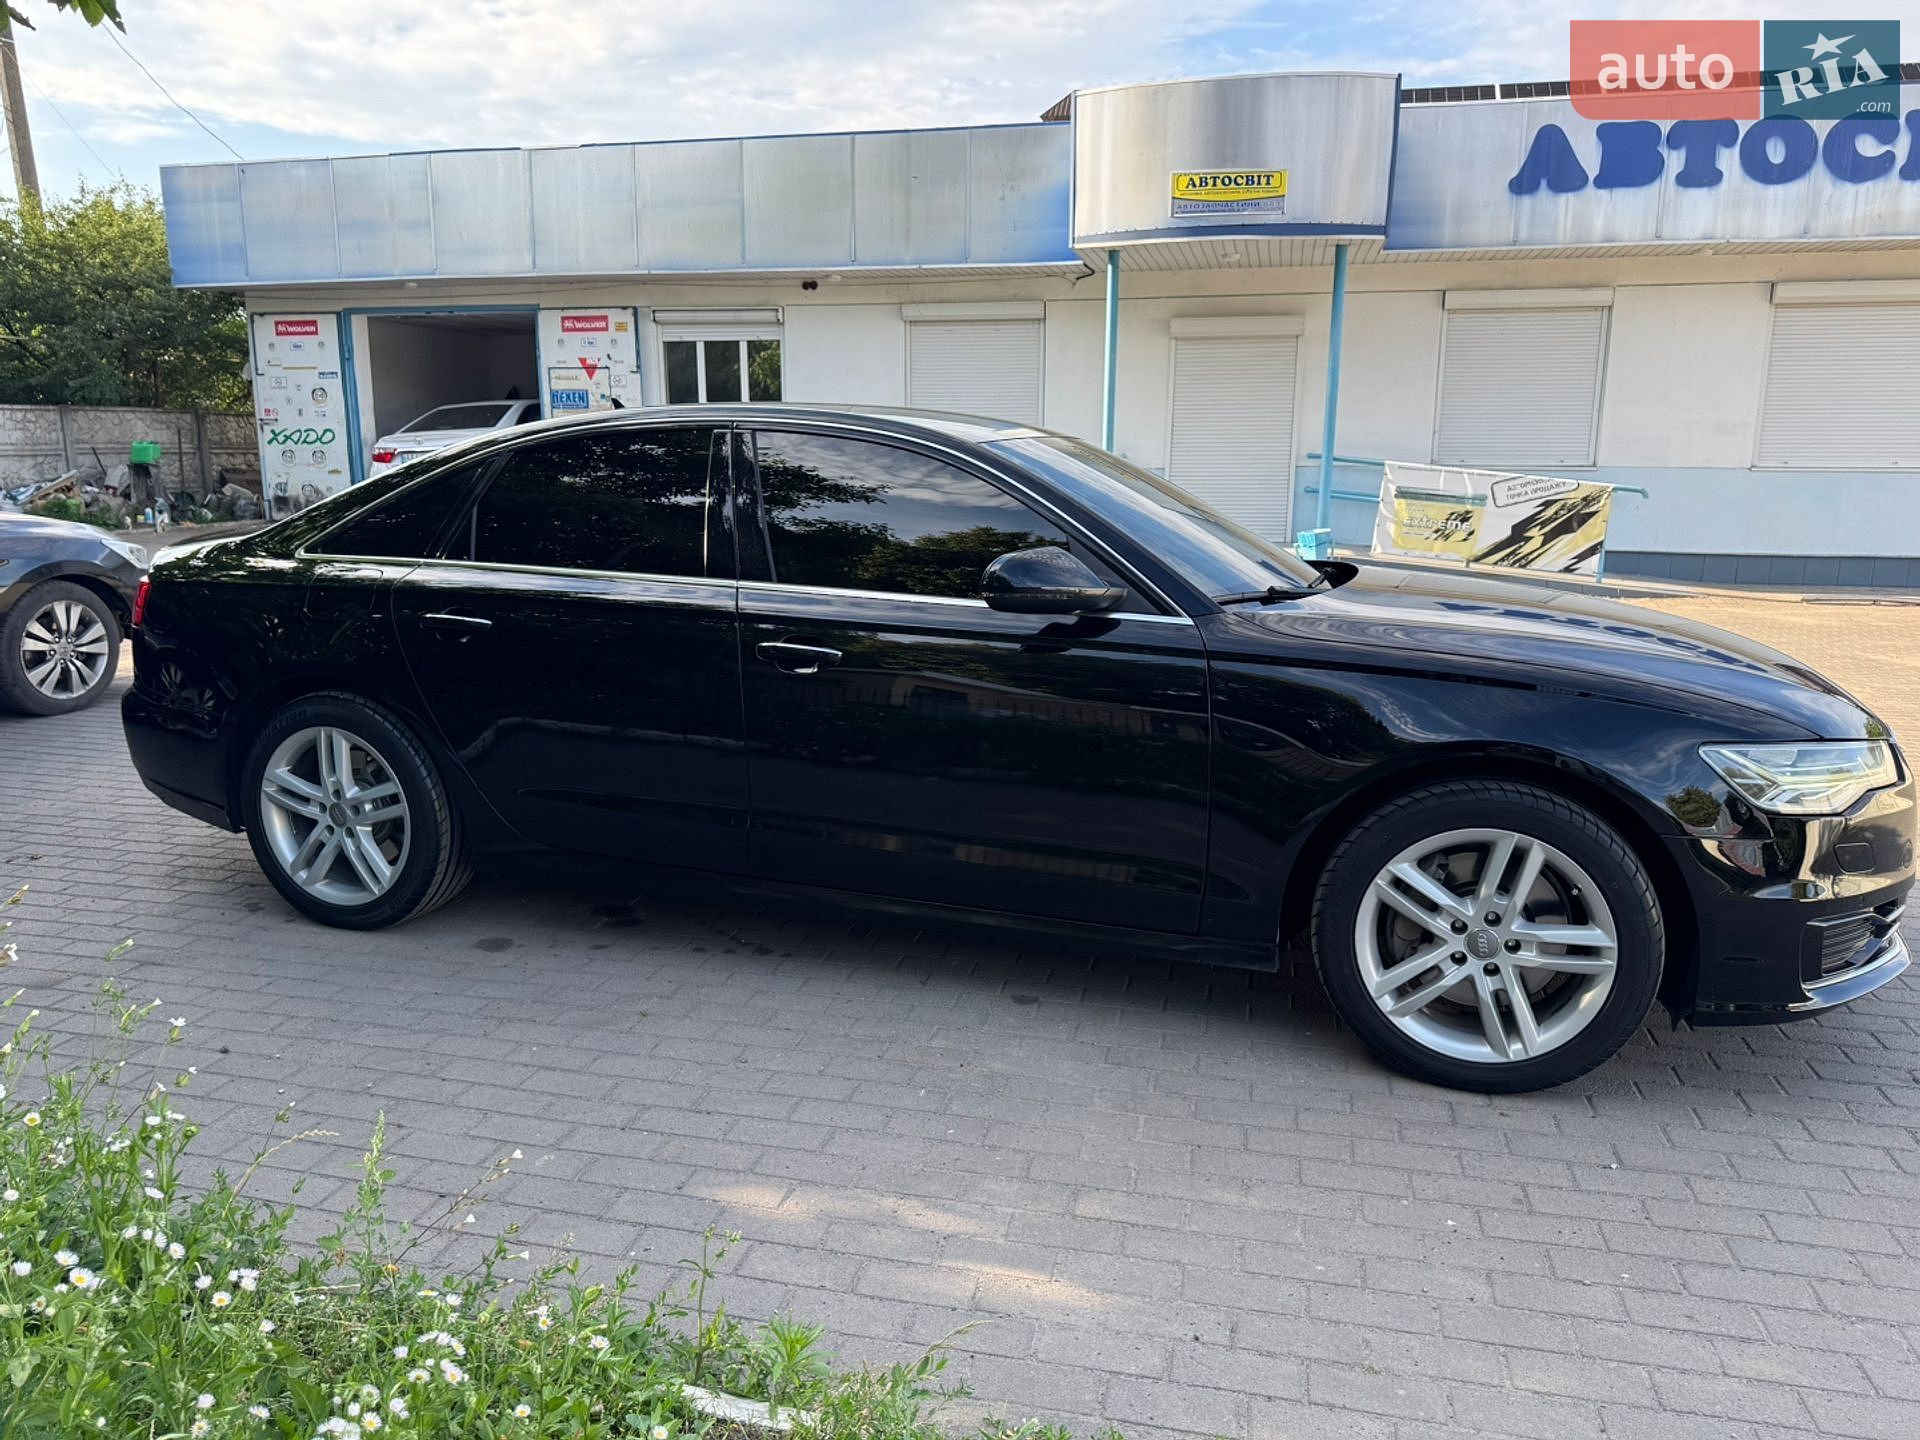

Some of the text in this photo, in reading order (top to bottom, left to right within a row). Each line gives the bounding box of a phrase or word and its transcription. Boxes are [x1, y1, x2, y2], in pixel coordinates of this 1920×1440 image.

[1508, 110, 1920, 195] АВТОС
[1186, 174, 1274, 189] АВТОСВІТ
[266, 427, 336, 446] XADO
